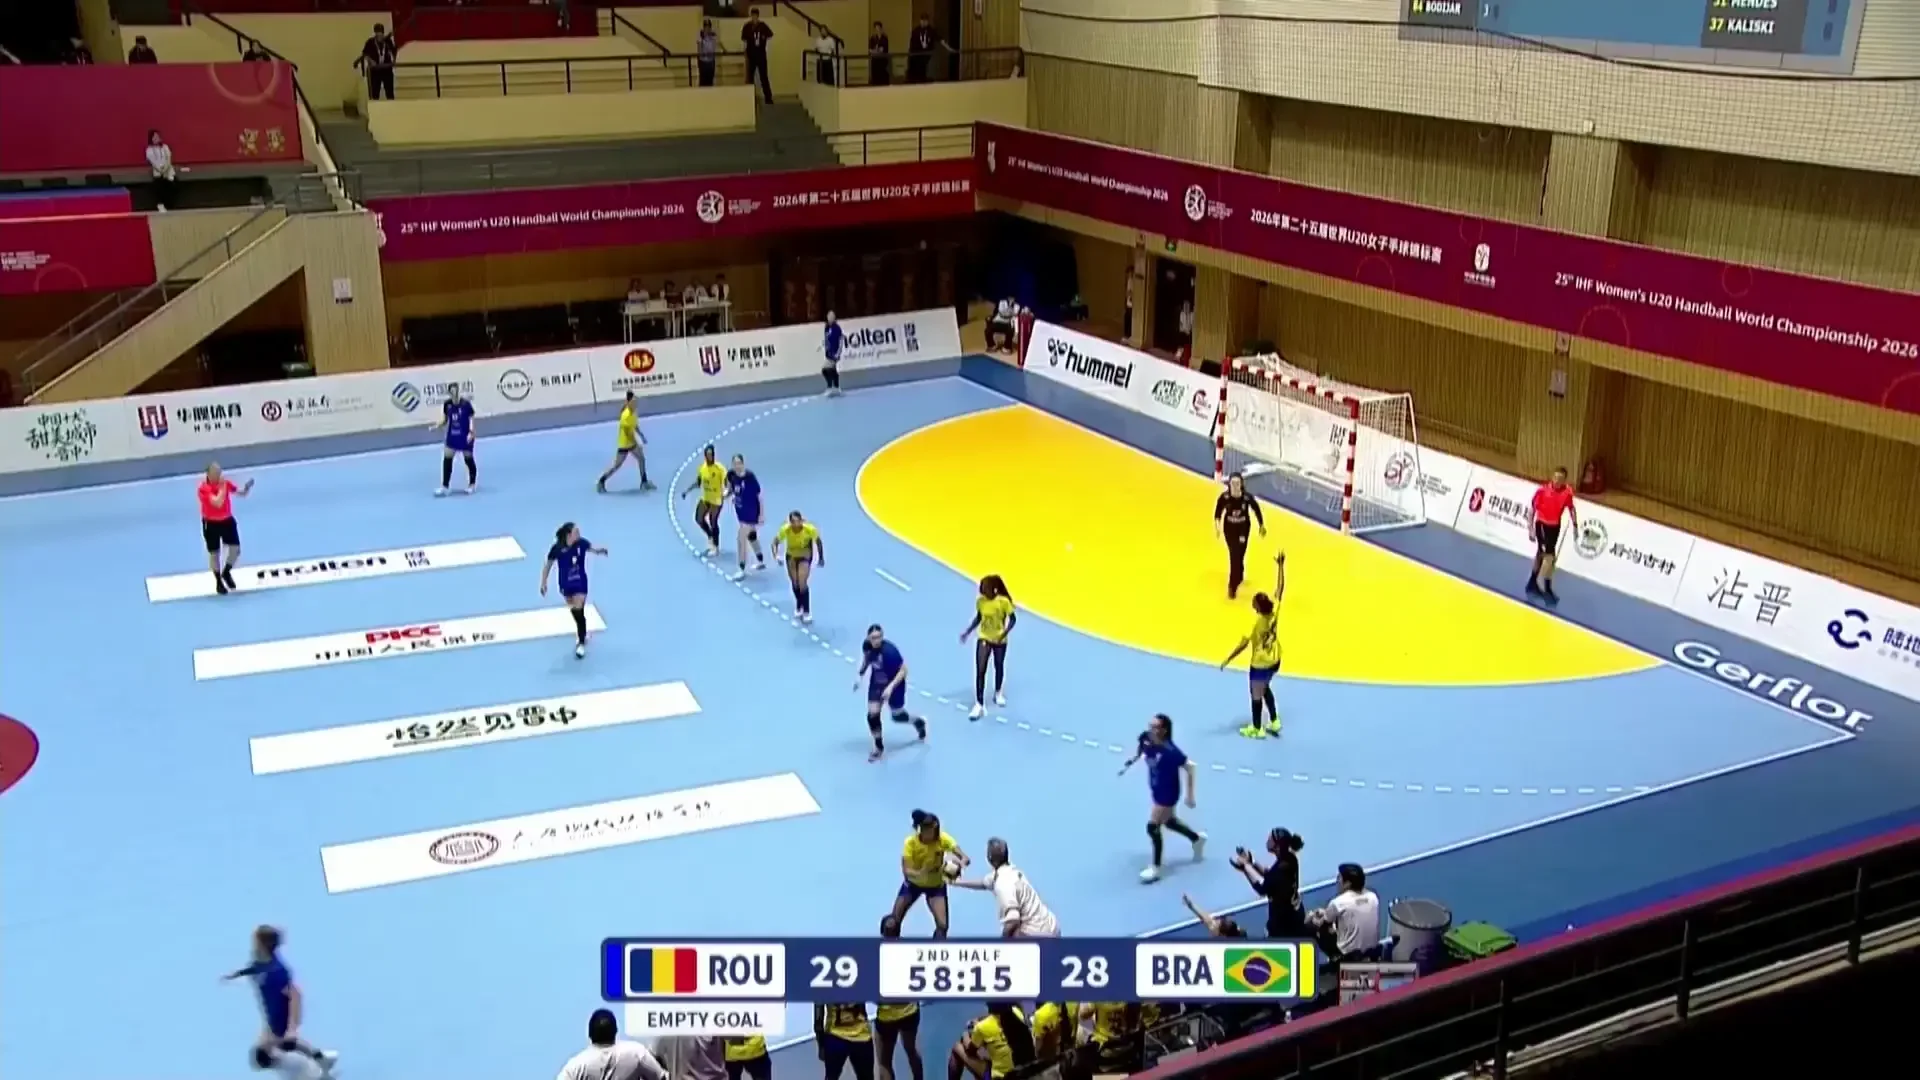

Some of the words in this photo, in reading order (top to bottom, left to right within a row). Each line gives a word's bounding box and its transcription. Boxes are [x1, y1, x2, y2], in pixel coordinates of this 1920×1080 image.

[1709, 17, 1724, 31] 37
[1727, 19, 1775, 34] KALISKI
[1109, 177, 1152, 200] Championship
[440, 216, 488, 231] Women's
[489, 215, 510, 228] U20
[512, 212, 558, 226] Handball
[560, 210, 590, 222] World
[591, 205, 660, 221] Championship
[661, 203, 685, 215] 2026
[1575, 275, 1594, 293] IHF
[1595, 280, 1646, 303] Women's
[1649, 291, 1673, 309] U20
[1675, 296, 1733, 322] Handball
[1735, 307, 1774, 329] World
[1776, 317, 1878, 354] Championship
[1881, 337, 1918, 359] 2026
[843, 327, 897, 350] olten
[1065, 344, 1133, 390] hummel
[365, 624, 442, 644] PICC
[1672, 640, 1874, 729] Gerflor
